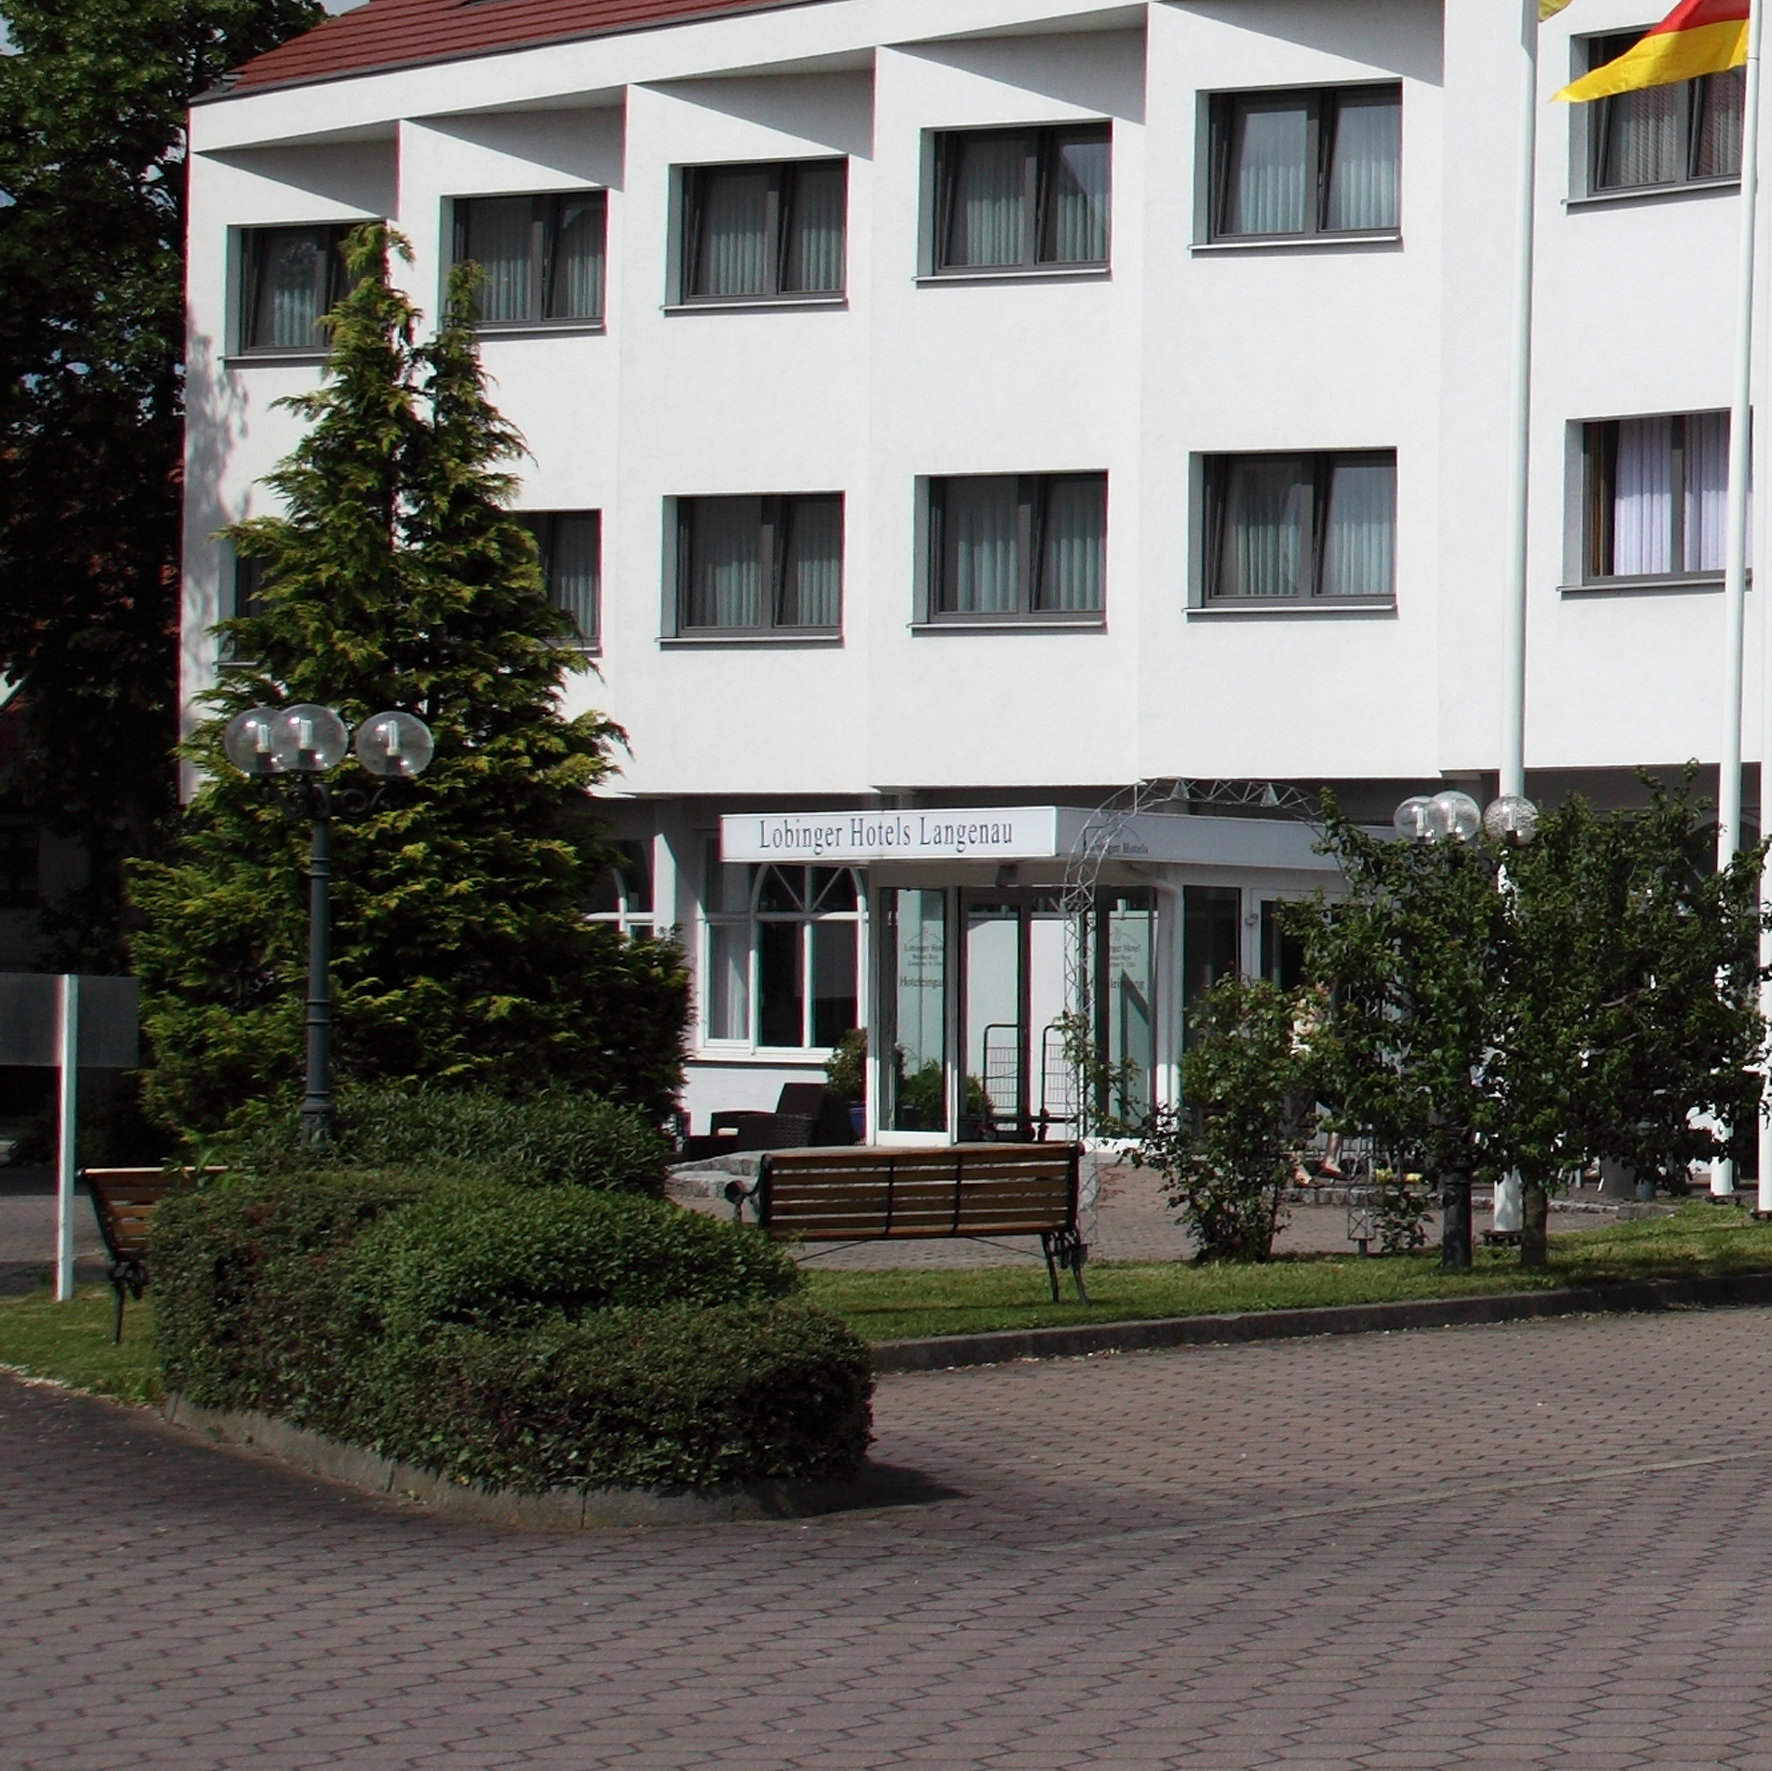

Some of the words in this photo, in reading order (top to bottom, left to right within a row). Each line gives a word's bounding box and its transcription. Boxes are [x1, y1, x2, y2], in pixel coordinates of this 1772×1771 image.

[759, 819, 843, 855] Lobinger
[850, 817, 911, 846] Hotels
[919, 816, 1013, 853] Langenau
